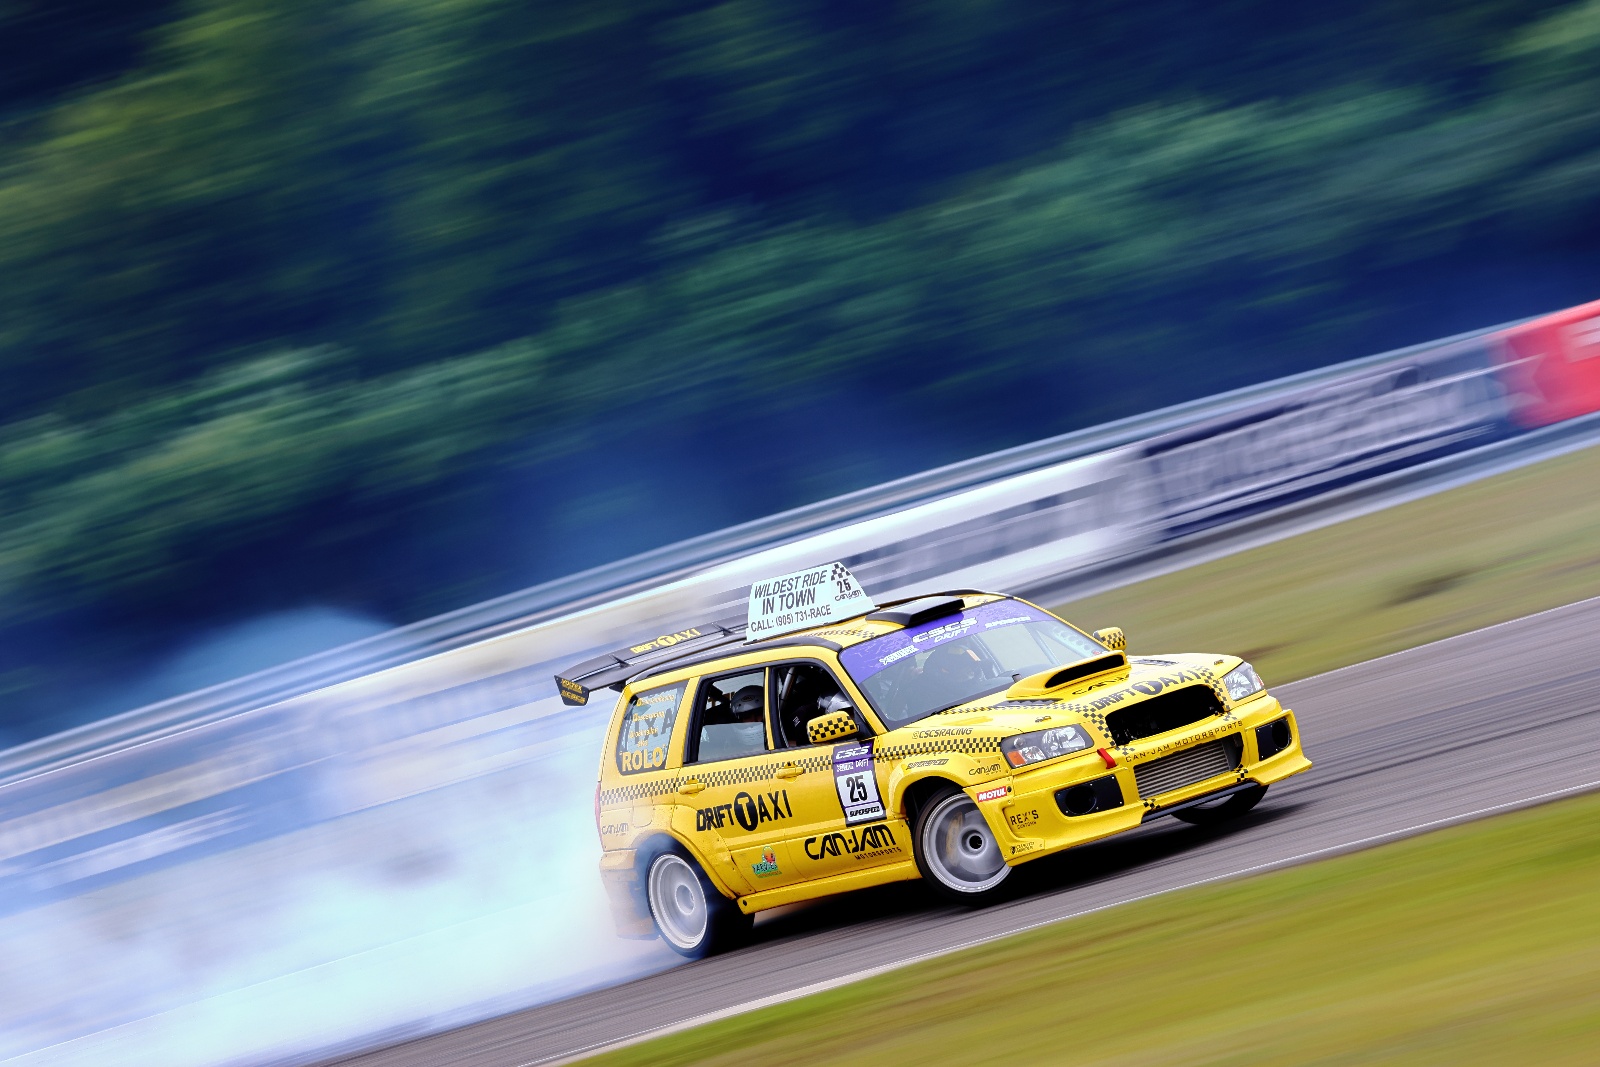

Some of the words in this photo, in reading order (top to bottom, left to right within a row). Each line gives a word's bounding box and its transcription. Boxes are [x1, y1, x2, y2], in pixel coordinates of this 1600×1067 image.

[754, 576, 801, 599] WILDEST
[802, 570, 827, 589] RIDE
[837, 579, 851, 593] 25
[762, 597, 774, 615] IN
[779, 587, 816, 611] TOWN
[750, 619, 775, 632] CALL:
[775, 613, 793, 627] (905)
[795, 604, 831, 621] 731-RACE
[912, 617, 978, 643] CSCS
[630, 641, 659, 654] DRIFT
[934, 627, 969, 643] DRIFT
[1089, 688, 1137, 711] DRIFT
[1131, 669, 1201, 695] TAXI
[835, 746, 870, 759] CSCS
[1125, 744, 1171, 763] CAN-JAM
[1175, 721, 1243, 748] MOTORSPORTS
[846, 775, 868, 803] 25
[978, 787, 1006, 801] MOTUL
[696, 803, 734, 832] DRIFT
[734, 789, 793, 832] TAXI
[1010, 810, 1039, 825] REX'S
[854, 848, 902, 861] MOTORSPORTS
